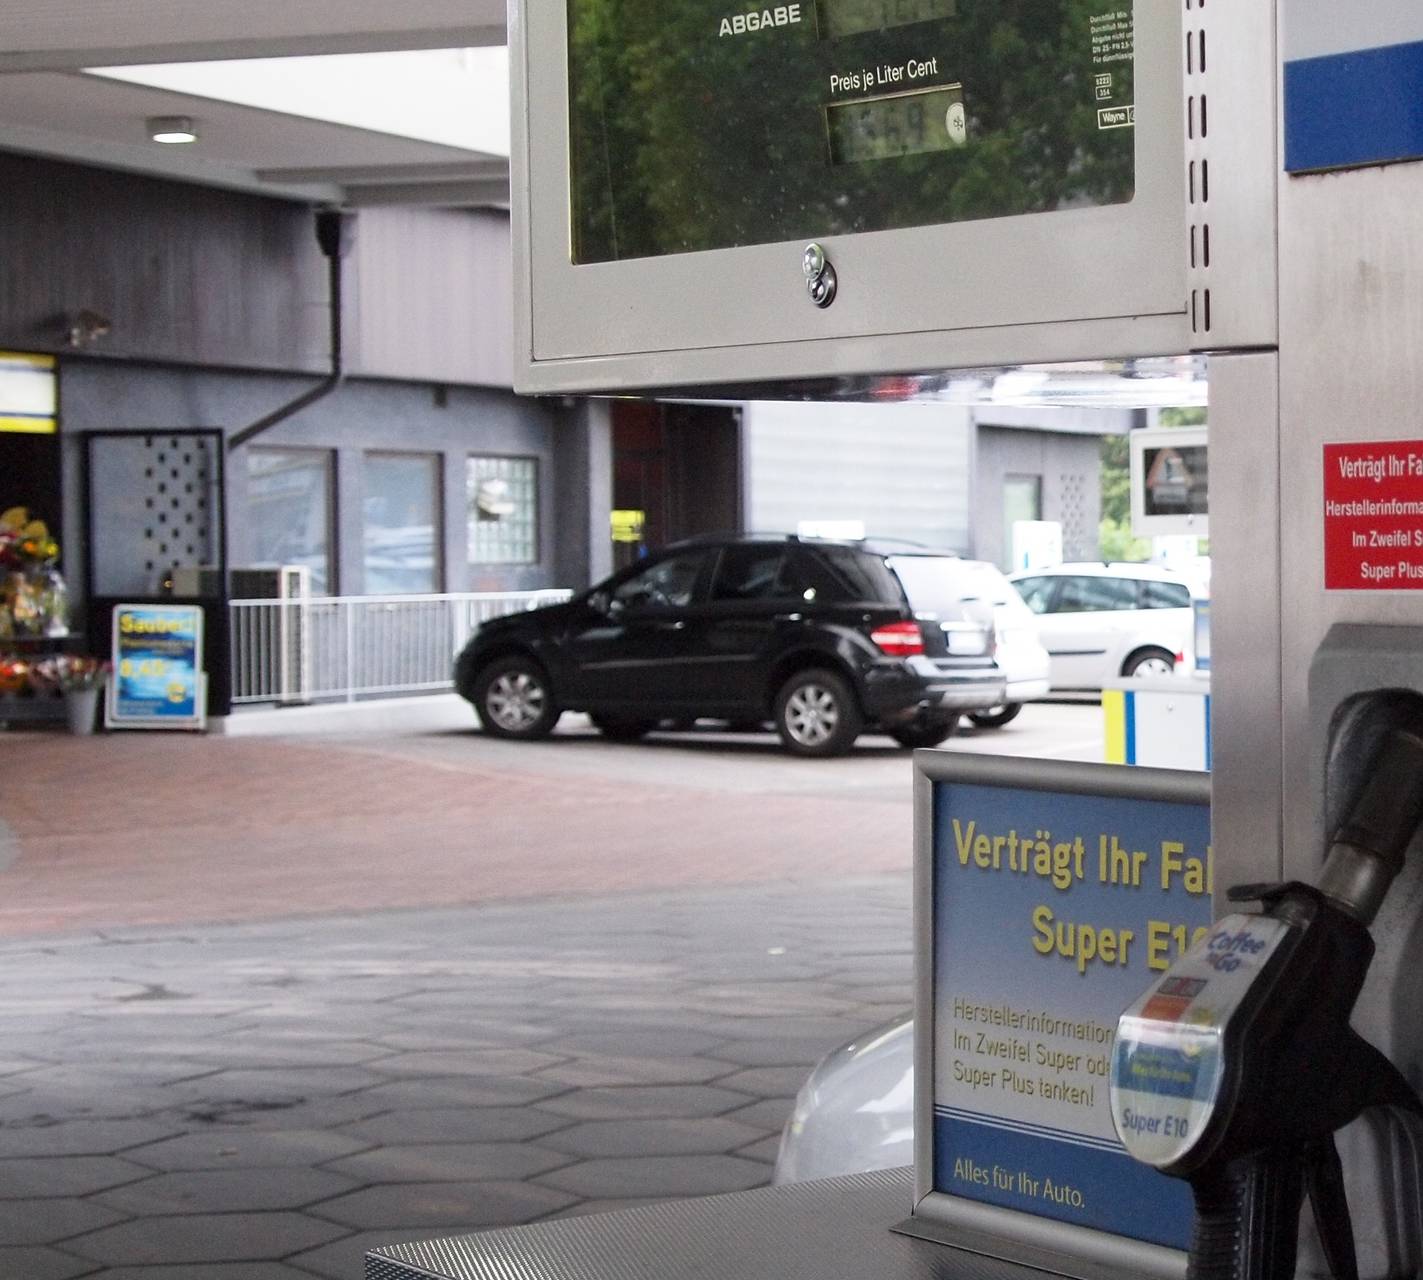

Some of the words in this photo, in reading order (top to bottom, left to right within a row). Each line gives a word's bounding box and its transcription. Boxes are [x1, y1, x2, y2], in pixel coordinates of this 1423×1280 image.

[719, 4, 801, 37] ABGABE
[830, 74, 860, 93] Preis
[863, 70, 874, 91] je
[876, 65, 904, 85] Liter
[906, 57, 938, 79] Cent
[1102, 111, 1126, 123] Wayne
[1339, 455, 1386, 482] Verträgt
[1389, 454, 1405, 476] Ihr
[1352, 531, 1366, 547] Im
[1370, 530, 1411, 547] Zweifel
[1360, 562, 1395, 582] Super
[1399, 562, 1423, 578] Plus
[952, 818, 1084, 890] Verträgt
[1100, 834, 1148, 886] Ihr
[1032, 905, 1134, 974] Super
[1207, 931, 1265, 955] Coffee
[954, 998, 1113, 1044] Herstellerinformation
[954, 1031, 970, 1051] Im
[976, 1032, 1030, 1063] Zweifel
[1036, 1044, 1080, 1075] Super
[954, 1060, 996, 1090] Super
[1002, 1068, 1034, 1096] Plus
[1040, 1077, 1094, 1108] tanken!
[1122, 1108, 1160, 1135] Super
[1164, 1115, 1190, 1139] E10
[954, 1158, 989, 1185] Alles
[993, 1164, 1014, 1191] für
[1018, 1171, 1039, 1197] Ihr
[1043, 1178, 1086, 1208] Auto.
